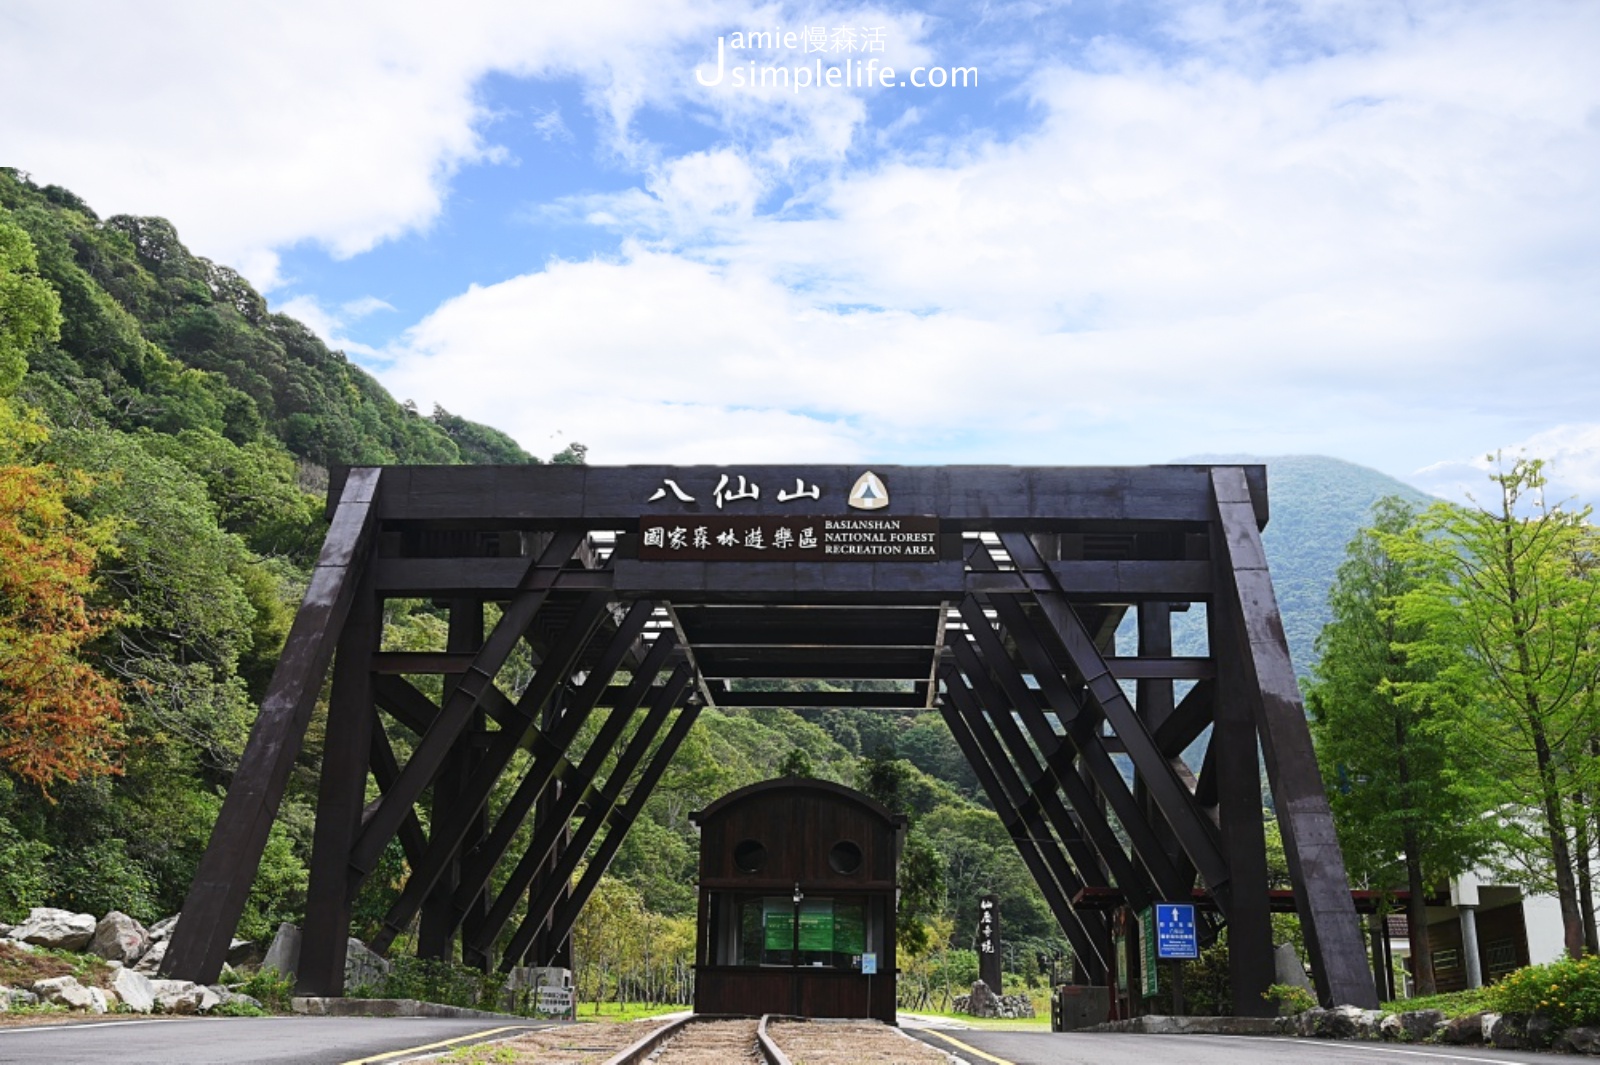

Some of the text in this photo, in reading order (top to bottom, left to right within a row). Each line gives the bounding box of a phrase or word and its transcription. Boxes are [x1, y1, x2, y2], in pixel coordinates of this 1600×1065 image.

[648, 473, 820, 509] 八仙山
[824, 520, 900, 530] BASIANSHAN
[643, 526, 818, 550] 國家森林遊樂區
[824, 532, 936, 542] NATIONAL FOREST
[824, 545, 936, 555] RECREATION AREA
